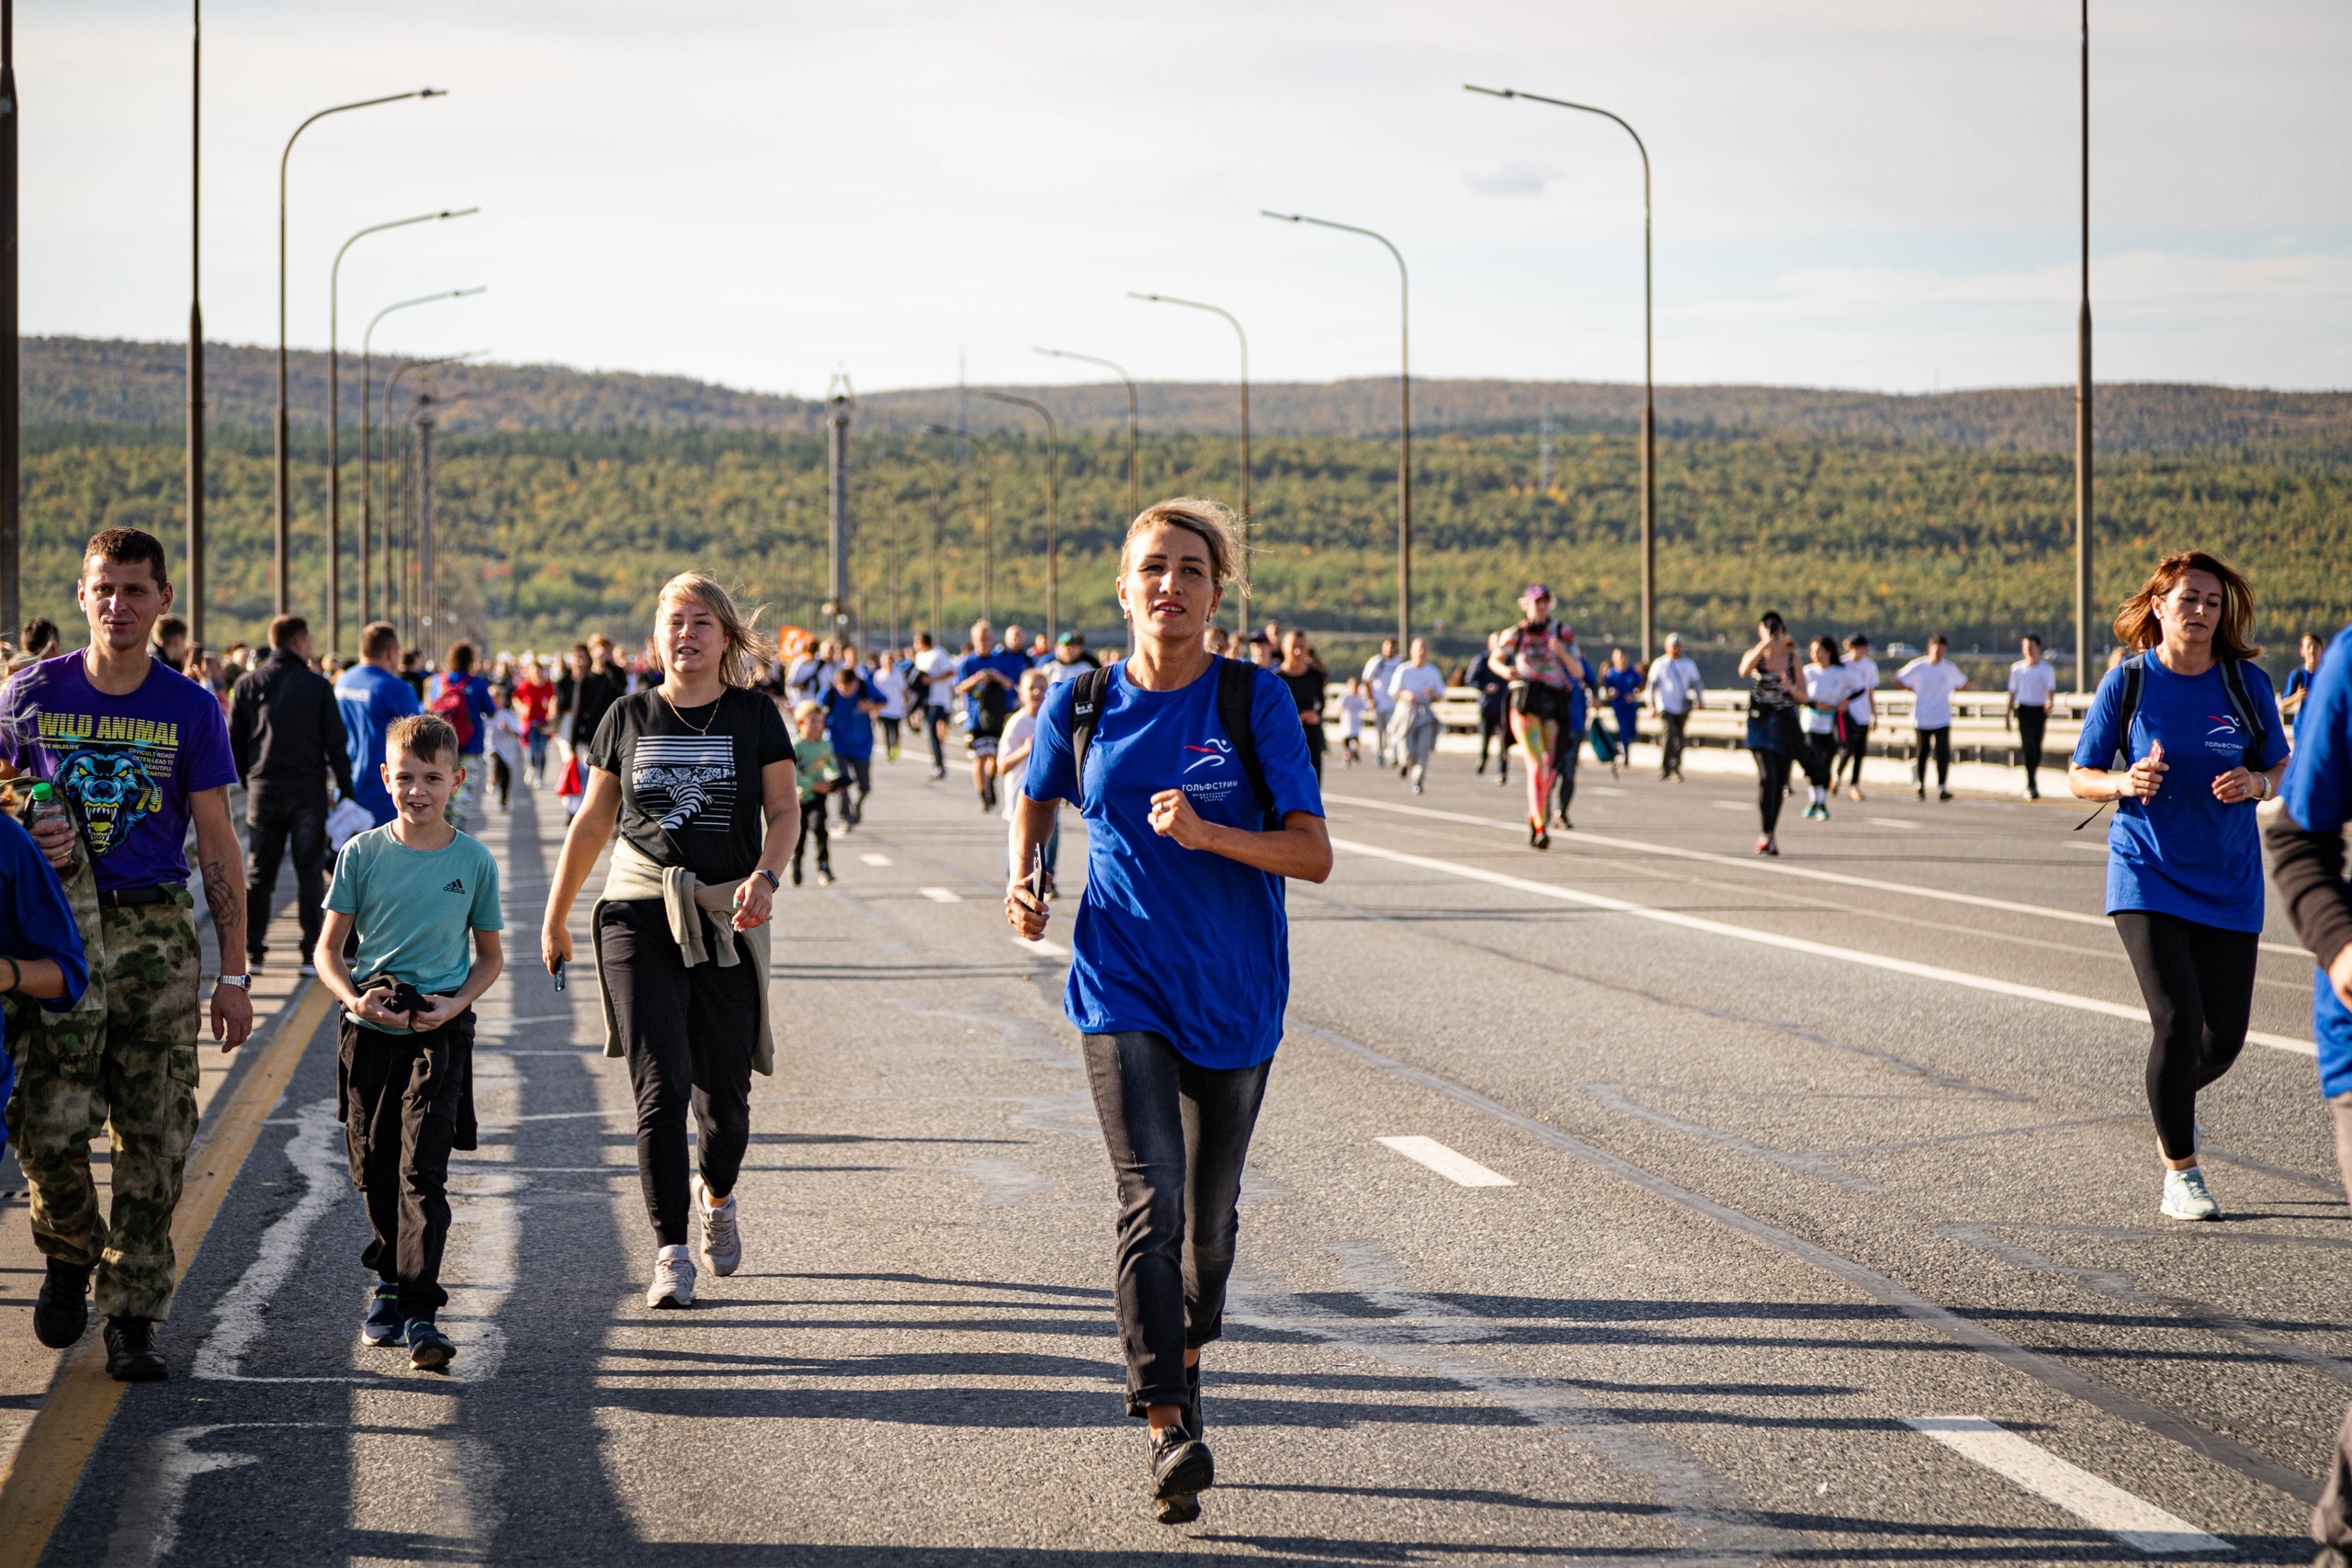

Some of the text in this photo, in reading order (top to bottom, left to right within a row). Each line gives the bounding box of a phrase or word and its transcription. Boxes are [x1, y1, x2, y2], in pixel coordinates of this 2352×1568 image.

[38, 711, 178, 746] WILD ANIMAL
[128, 748, 155, 757] DIFFICULT
[1182, 780, 1238, 791] ГОЛЬФСТРИМ
[444, 886, 465, 895] adidas
